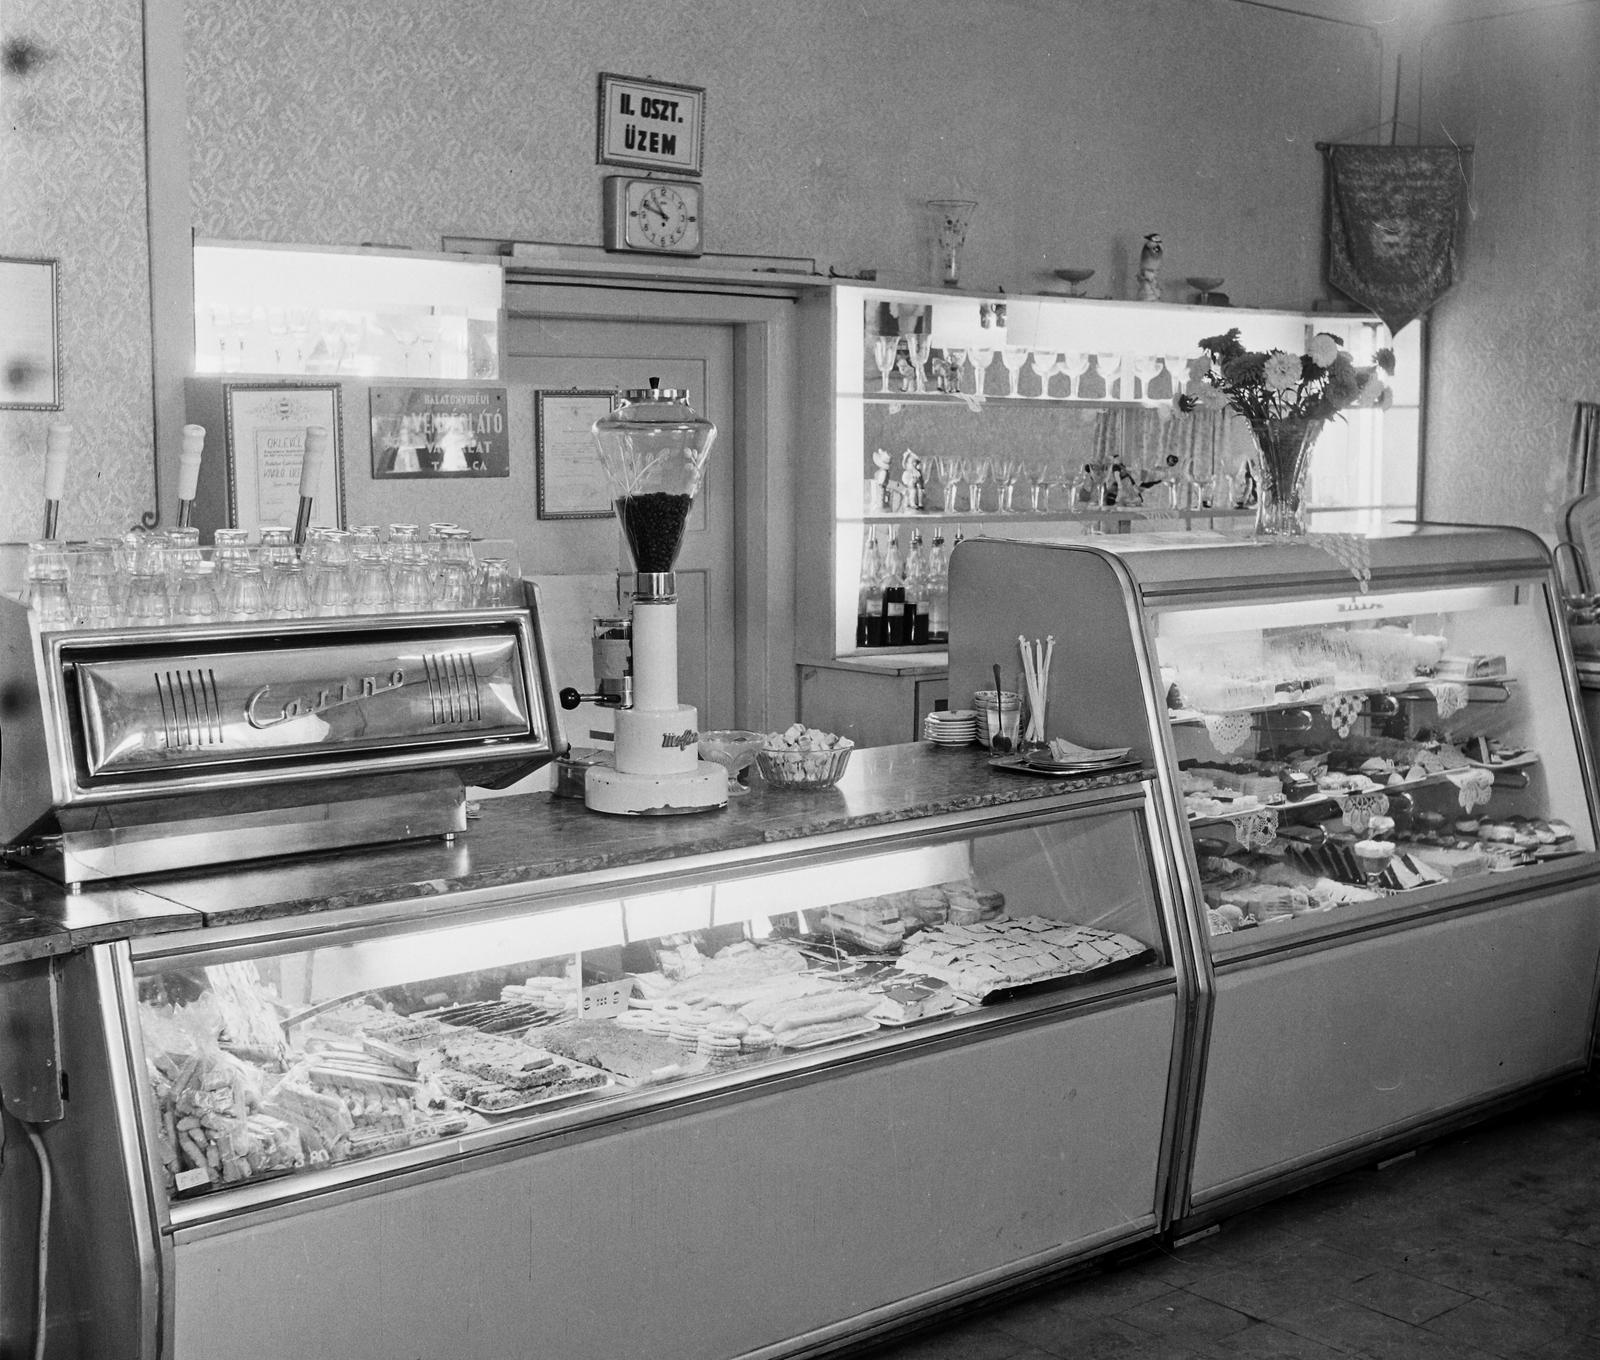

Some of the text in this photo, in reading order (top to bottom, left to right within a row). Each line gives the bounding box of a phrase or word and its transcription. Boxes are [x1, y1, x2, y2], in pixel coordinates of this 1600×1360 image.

[620, 93, 683, 123] II. OSZT.
[625, 123, 676, 156] ÜZEM
